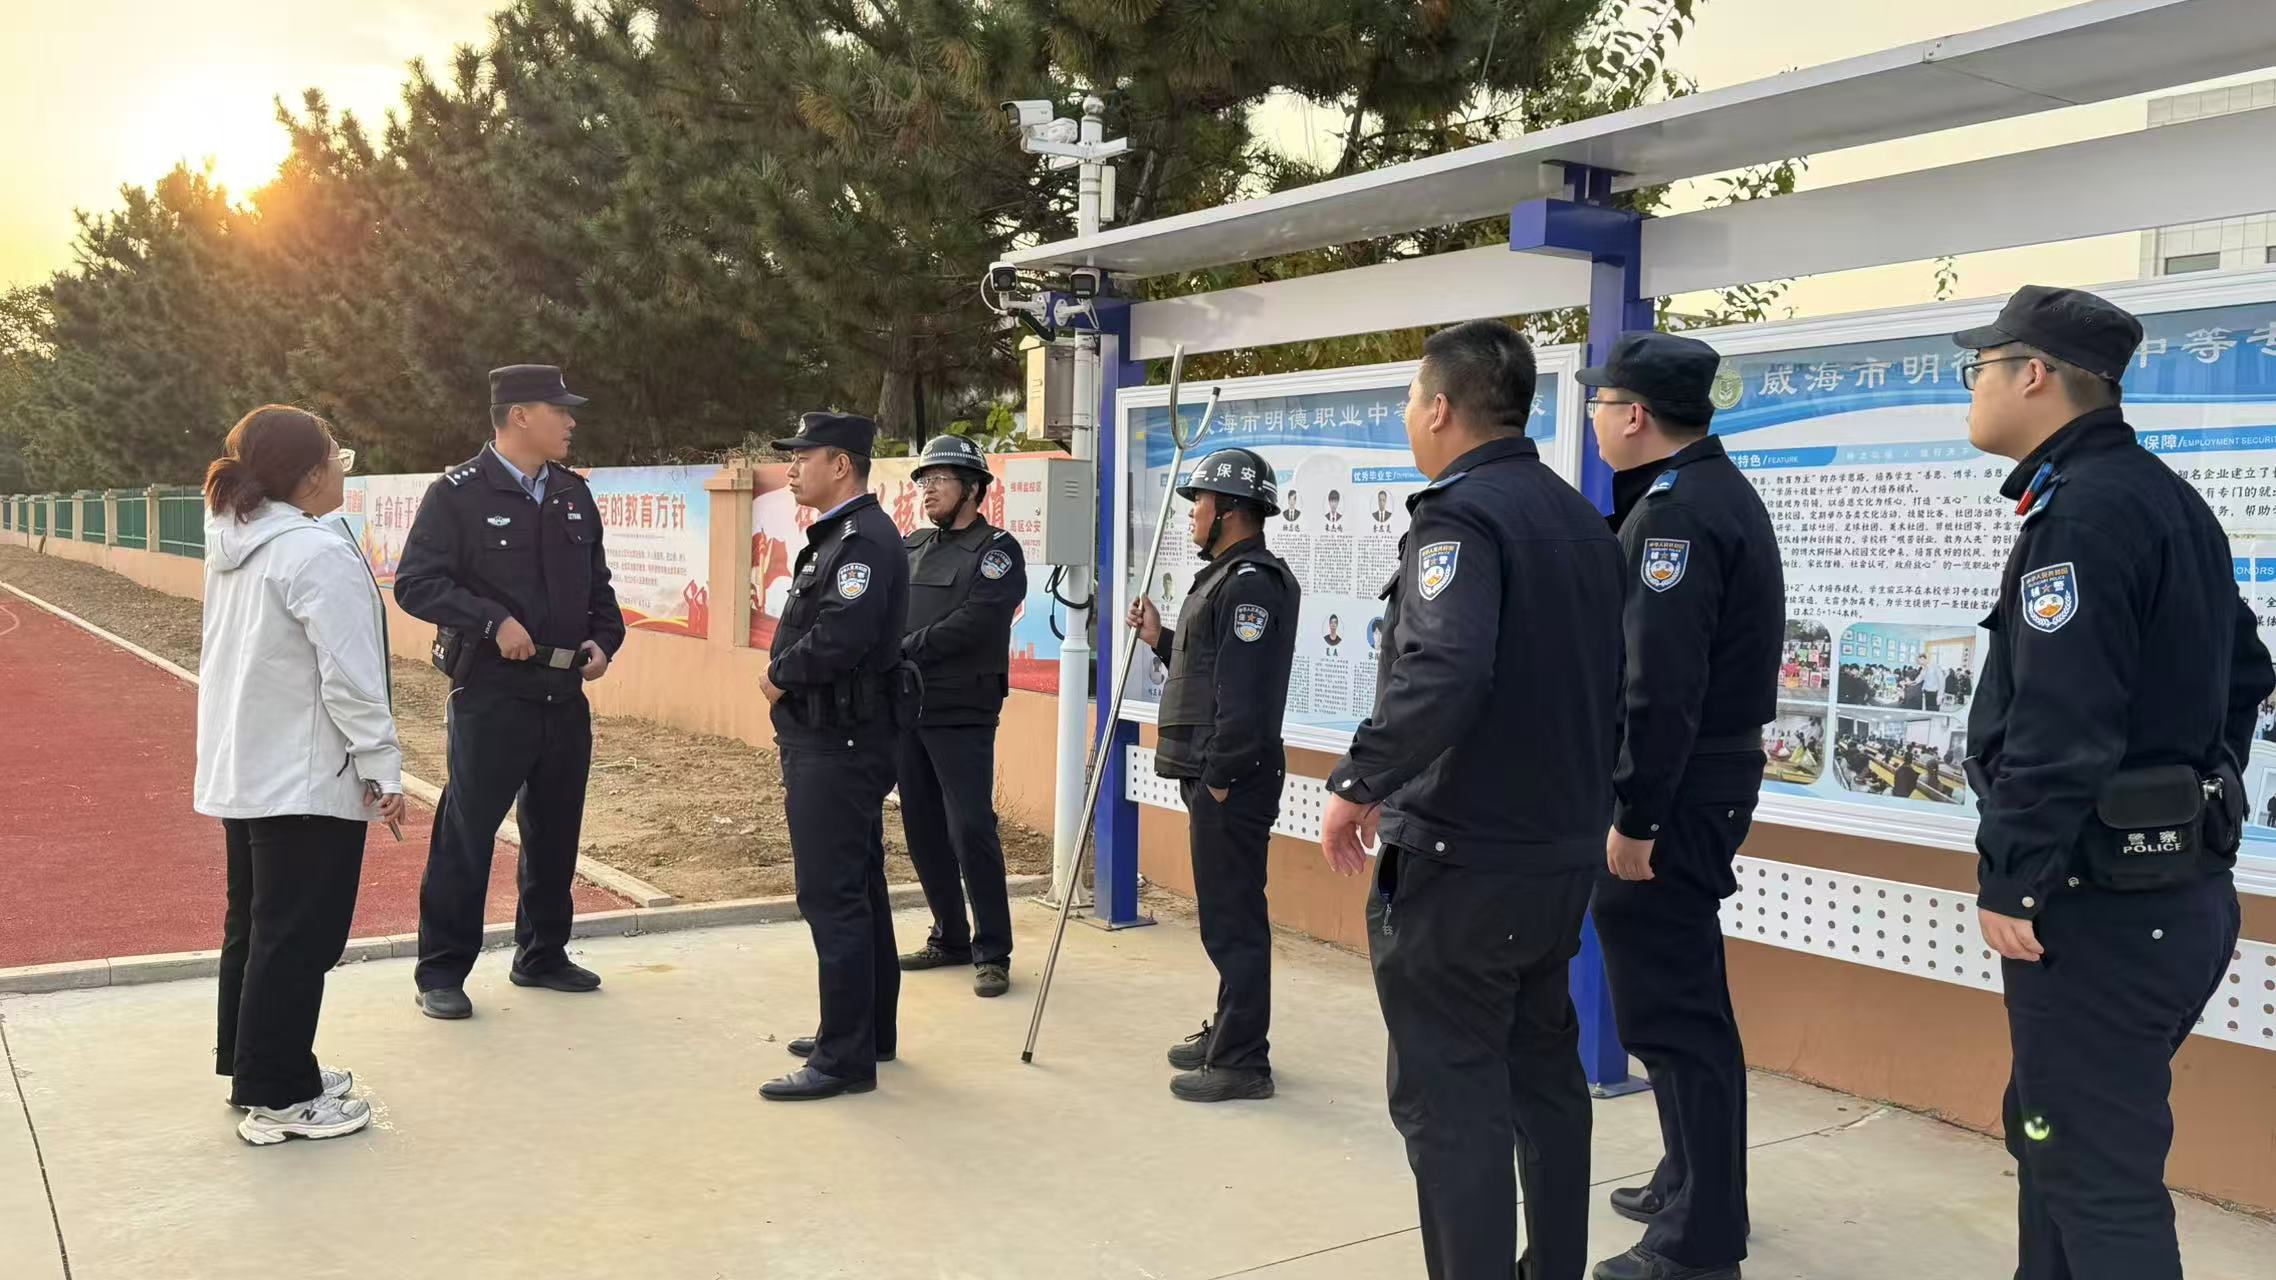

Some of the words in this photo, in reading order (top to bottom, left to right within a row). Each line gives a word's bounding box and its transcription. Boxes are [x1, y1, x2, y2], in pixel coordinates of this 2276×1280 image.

[1199, 402, 1407, 435] 海市明德职业中等
[1216, 463, 1256, 483] 保安
[2178, 467, 2276, 480] 知名企业建立了
[2198, 486, 2276, 499] 有专门的就
[596, 493, 686, 529] 党的教育方针
[2235, 566, 2275, 576] ONORS
[2128, 830, 2178, 846] 警察
[2123, 842, 2182, 854] POLICE
